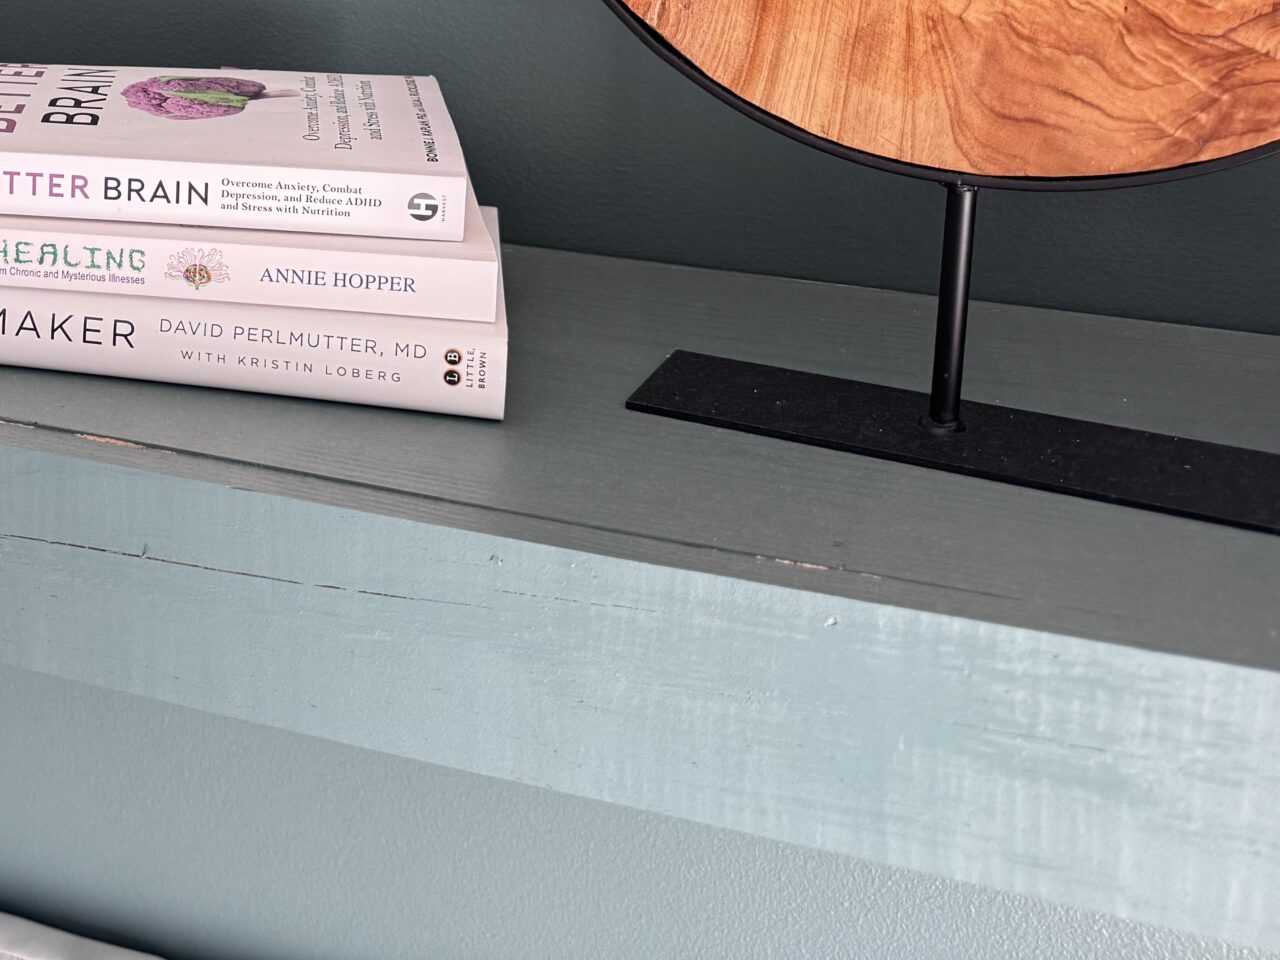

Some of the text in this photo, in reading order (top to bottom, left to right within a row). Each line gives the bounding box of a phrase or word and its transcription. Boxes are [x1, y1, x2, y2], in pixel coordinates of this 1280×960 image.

[40, 68, 118, 126] BRAIN
[303, 112, 320, 141] Overcome
[363, 112, 380, 127] Stress
[363, 128, 382, 140] and
[103, 176, 209, 207] BRAIN
[221, 177, 362, 195] Overcome Anxiety, Combat
[221, 189, 382, 208] Depression, and Reduce ADHD
[220, 201, 351, 218] and Stress with Nutrition
[9, 266, 41, 278] Chronic
[43, 269, 59, 279] and
[61, 270, 106, 283] Mysterious
[108, 273, 145, 285] Illnesses
[260, 267, 417, 293] ANNIE HOPPER
[159, 318, 427, 360] DAVID PERLMUTTER, MD
[180, 349, 402, 383] WITH KRISTIN LOBERG
[466, 348, 476, 388] LITTLE,
[478, 352, 487, 389] BROWN
